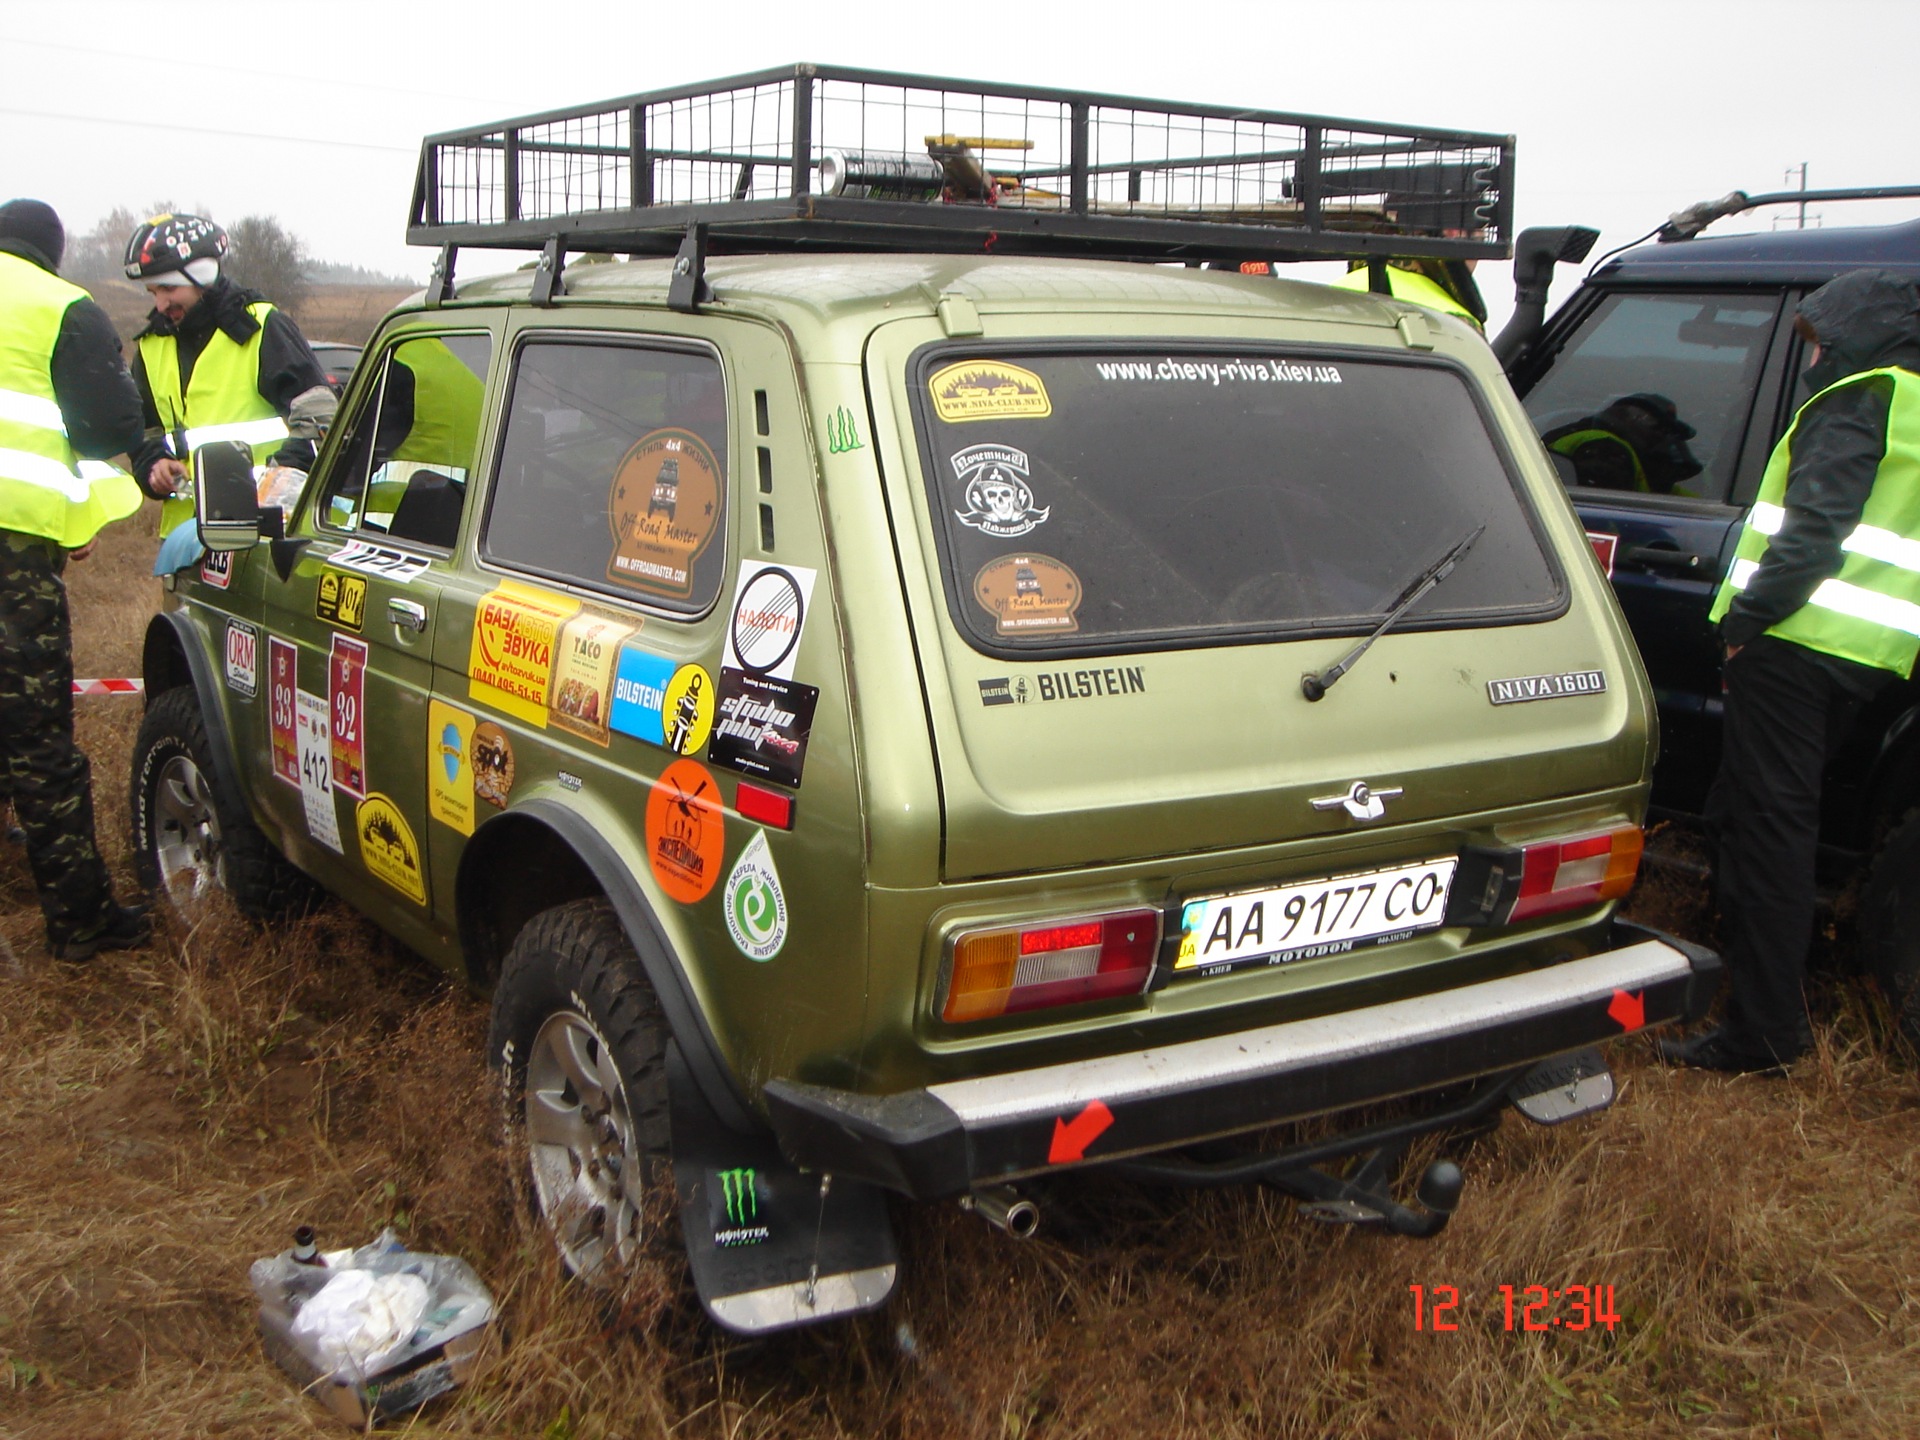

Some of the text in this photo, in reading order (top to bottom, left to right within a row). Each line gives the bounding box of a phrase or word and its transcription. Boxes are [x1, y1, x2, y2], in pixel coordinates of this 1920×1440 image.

[943, 398, 1042, 411] WWW.NIVA-CLUB.NET
[636, 517, 662, 543] Road
[663, 522, 699, 545] Master
[615, 555, 688, 583] WWW.OFFROADMASTER.COM
[737, 607, 796, 635] НАЛОГИ
[228, 629, 255, 673] ORM
[502, 631, 550, 669] ЗВУКА
[574, 636, 602, 660] TACO
[616, 677, 664, 713] BILSTEIN
[743, 676, 789, 695] Tuning and Service
[981, 687, 1009, 698] BILSTEIN
[1037, 666, 1146, 701] BILSTEIN
[1496, 672, 1601, 701] NIVA 1600
[275, 683, 292, 730] 33
[336, 691, 356, 743] 32
[720, 693, 797, 729] studio
[303, 747, 330, 795] 412
[657, 836, 704, 875] ЭКСПЕДИЦИЯ
[729, 863, 786, 922] ДЖЕРЕЛА ЖИВЛЕННЯ
[1202, 871, 1439, 955] AA 9177 CO
[1267, 939, 1354, 966] MOTODOM
